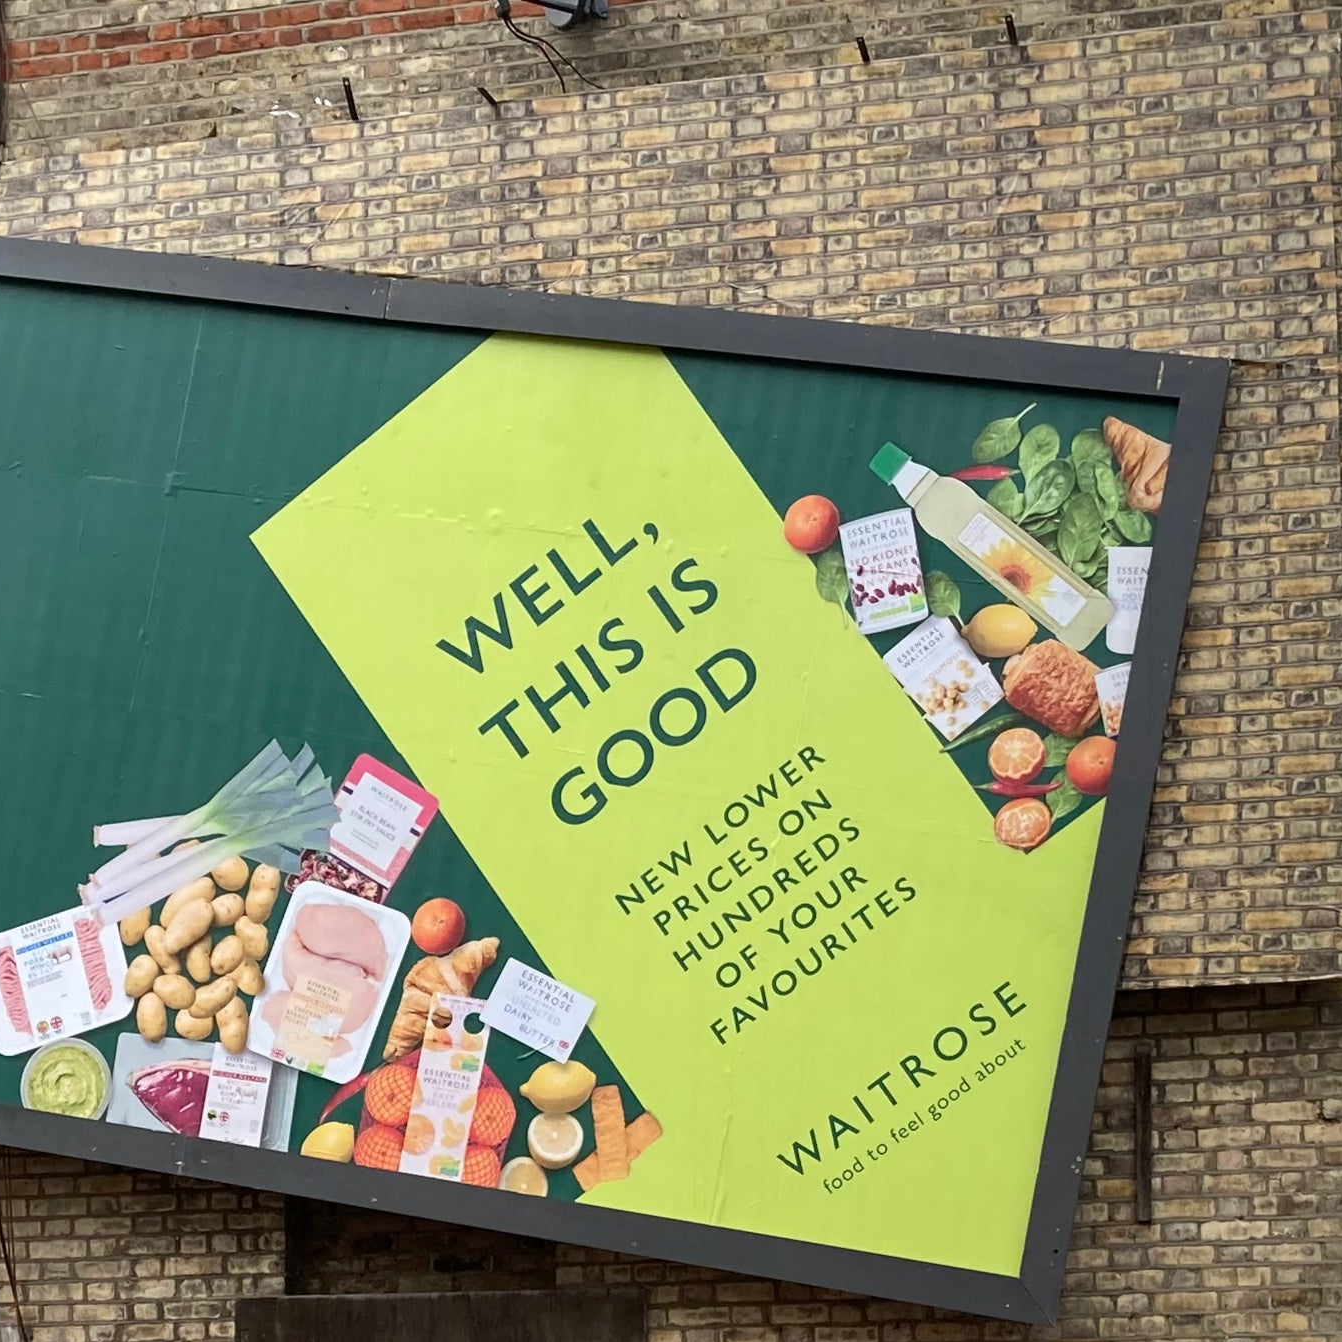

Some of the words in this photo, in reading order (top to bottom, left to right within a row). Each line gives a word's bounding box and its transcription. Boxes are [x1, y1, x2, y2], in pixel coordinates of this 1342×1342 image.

[846, 515, 907, 540] ESSENTIAL
[848, 527, 909, 549] WAITROSE
[435, 518, 659, 674] WELL,
[478, 617, 644, 760] THIS
[647, 557, 719, 634] IS
[897, 627, 940, 664] ESSENTIAL
[903, 631, 945, 669] WAITROSE
[551, 647, 757, 826] GOOD
[370, 786, 408, 812] WAITROSE
[614, 840, 692, 916] NEW
[703, 746, 826, 846] LOWER
[652, 836, 769, 937] PRICES
[778, 788, 833, 836] ON
[672, 817, 860, 972] HUNDREDS
[715, 943, 758, 988] OF
[766, 866, 868, 945] YOUR
[709, 877, 916, 1045] FAVOURITES
[518, 979, 572, 1013] WAITROSE
[520, 969, 575, 1004] ESSENTIAL
[503, 1003, 532, 1022] DAIRY
[518, 1024, 555, 1048] BUTTER
[423, 1068, 471, 1083] ESSENTIAL
[423, 1076, 470, 1091] WAITROSE
[776, 981, 1027, 1176] WAITROSE
[822, 1156, 865, 1194] food
[866, 1143, 888, 1162] to
[889, 1111, 925, 1144] feel
[927, 1076, 971, 1122] good
[974, 1038, 1027, 1082] about
